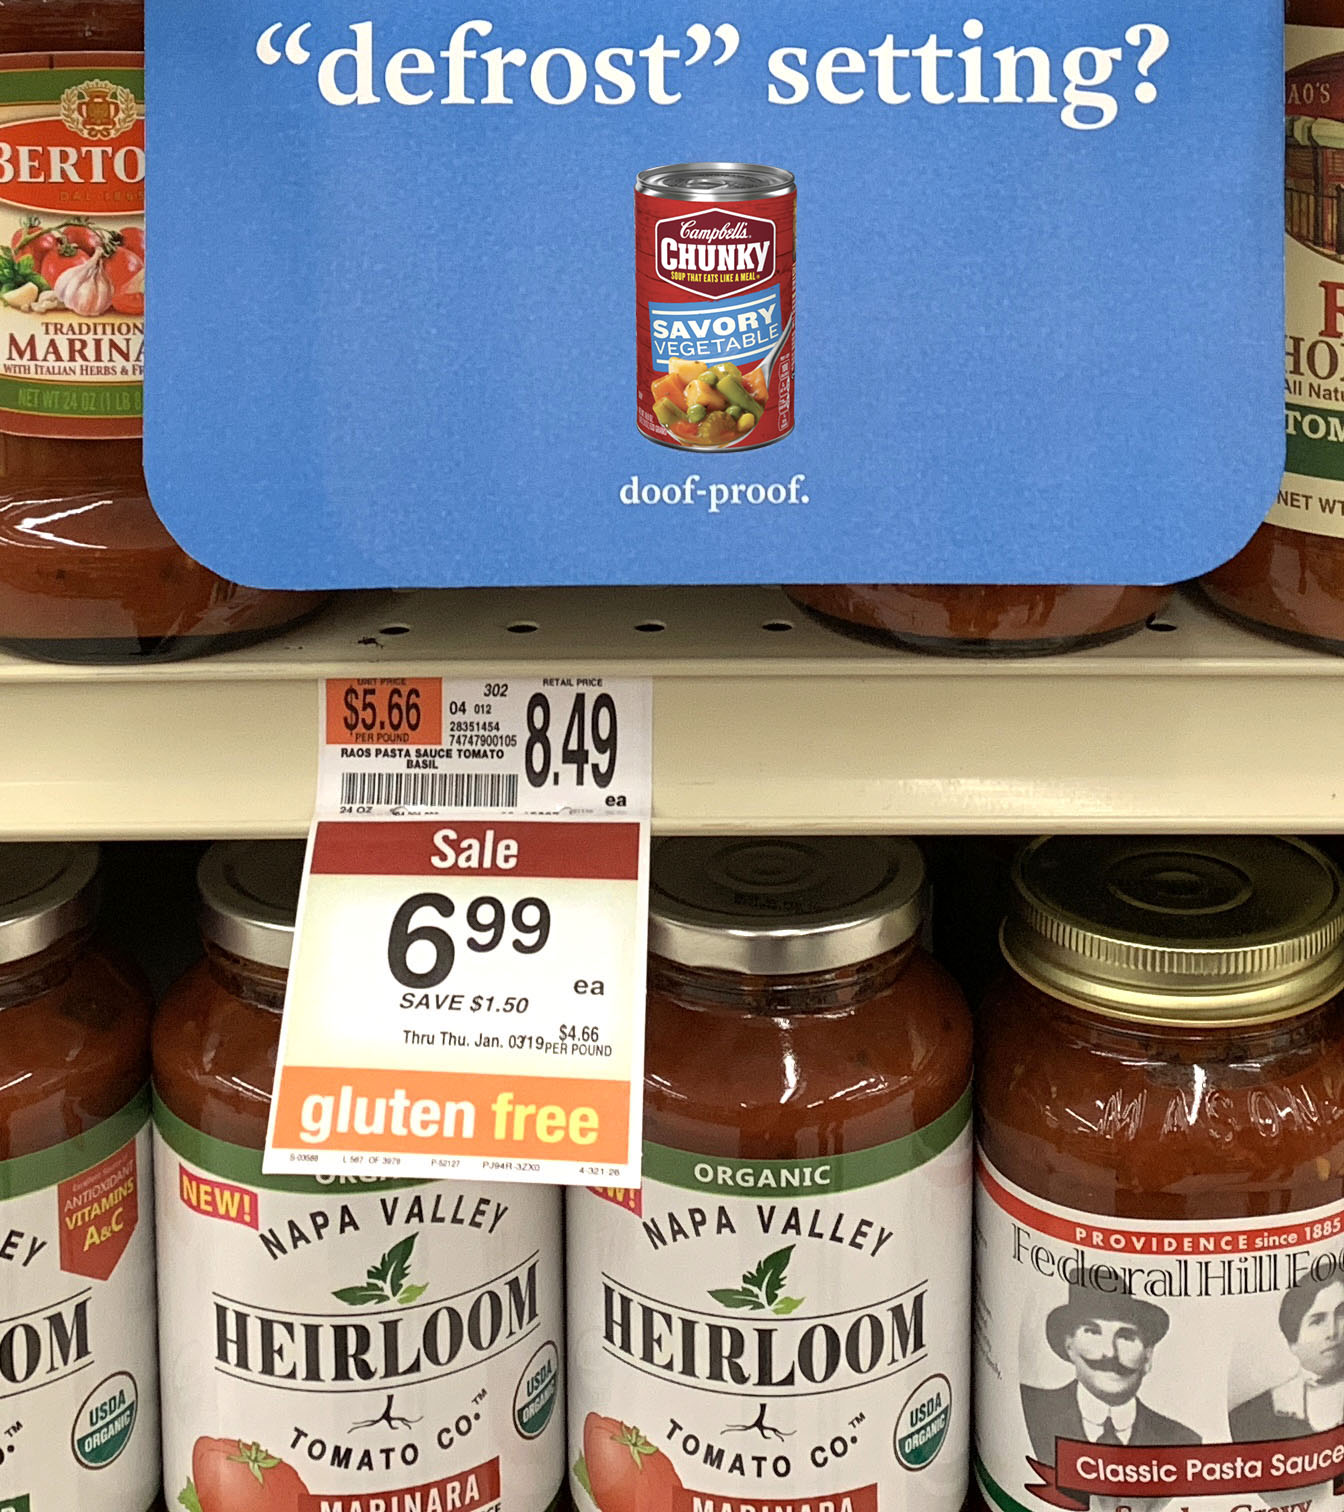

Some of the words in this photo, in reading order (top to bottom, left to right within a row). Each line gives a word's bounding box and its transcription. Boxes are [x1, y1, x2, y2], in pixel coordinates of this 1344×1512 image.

[766, 21, 1169, 129] setting?
[661, 238, 770, 272] CHUNKY
[671, 271, 686, 281] SOUP
[687, 272, 703, 282] THAT
[704, 273, 719, 283] EATS
[720, 273, 734, 283] LIKE
[735, 273, 739, 282] A
[740, 273, 755, 282] MEAL
[653, 304, 777, 340] SAVORY
[655, 324, 778, 355] VEGETABLE
[620, 475, 809, 512] doof-proof.
[341, 748, 371, 758] RAOS
[374, 748, 412, 759] PASTA
[415, 749, 453, 759] SAUCE
[456, 749, 504, 759] TOMATO
[343, 686, 421, 736] $5.66
[525, 692, 618, 788] 8.49
[407, 759, 438, 769] BASIL
[430, 829, 518, 869] Sale
[299, 1086, 475, 1142] gluten
[491, 1092, 600, 1145] free
[181, 1176, 252, 1222] NEW!
[1075, 1228, 1248, 1252] PROVIDENCE
[1254, 1233, 1297, 1248] since
[1304, 1218, 1341, 1240] 1885
[214, 1260, 539, 1382] HEIRLOOM
[602, 1282, 928, 1386] HEIRLOOM
[1076, 1456, 1177, 1483] Classic
[1186, 1457, 1262, 1481] Pasta
[1270, 1445, 1344, 1475] Sauce
